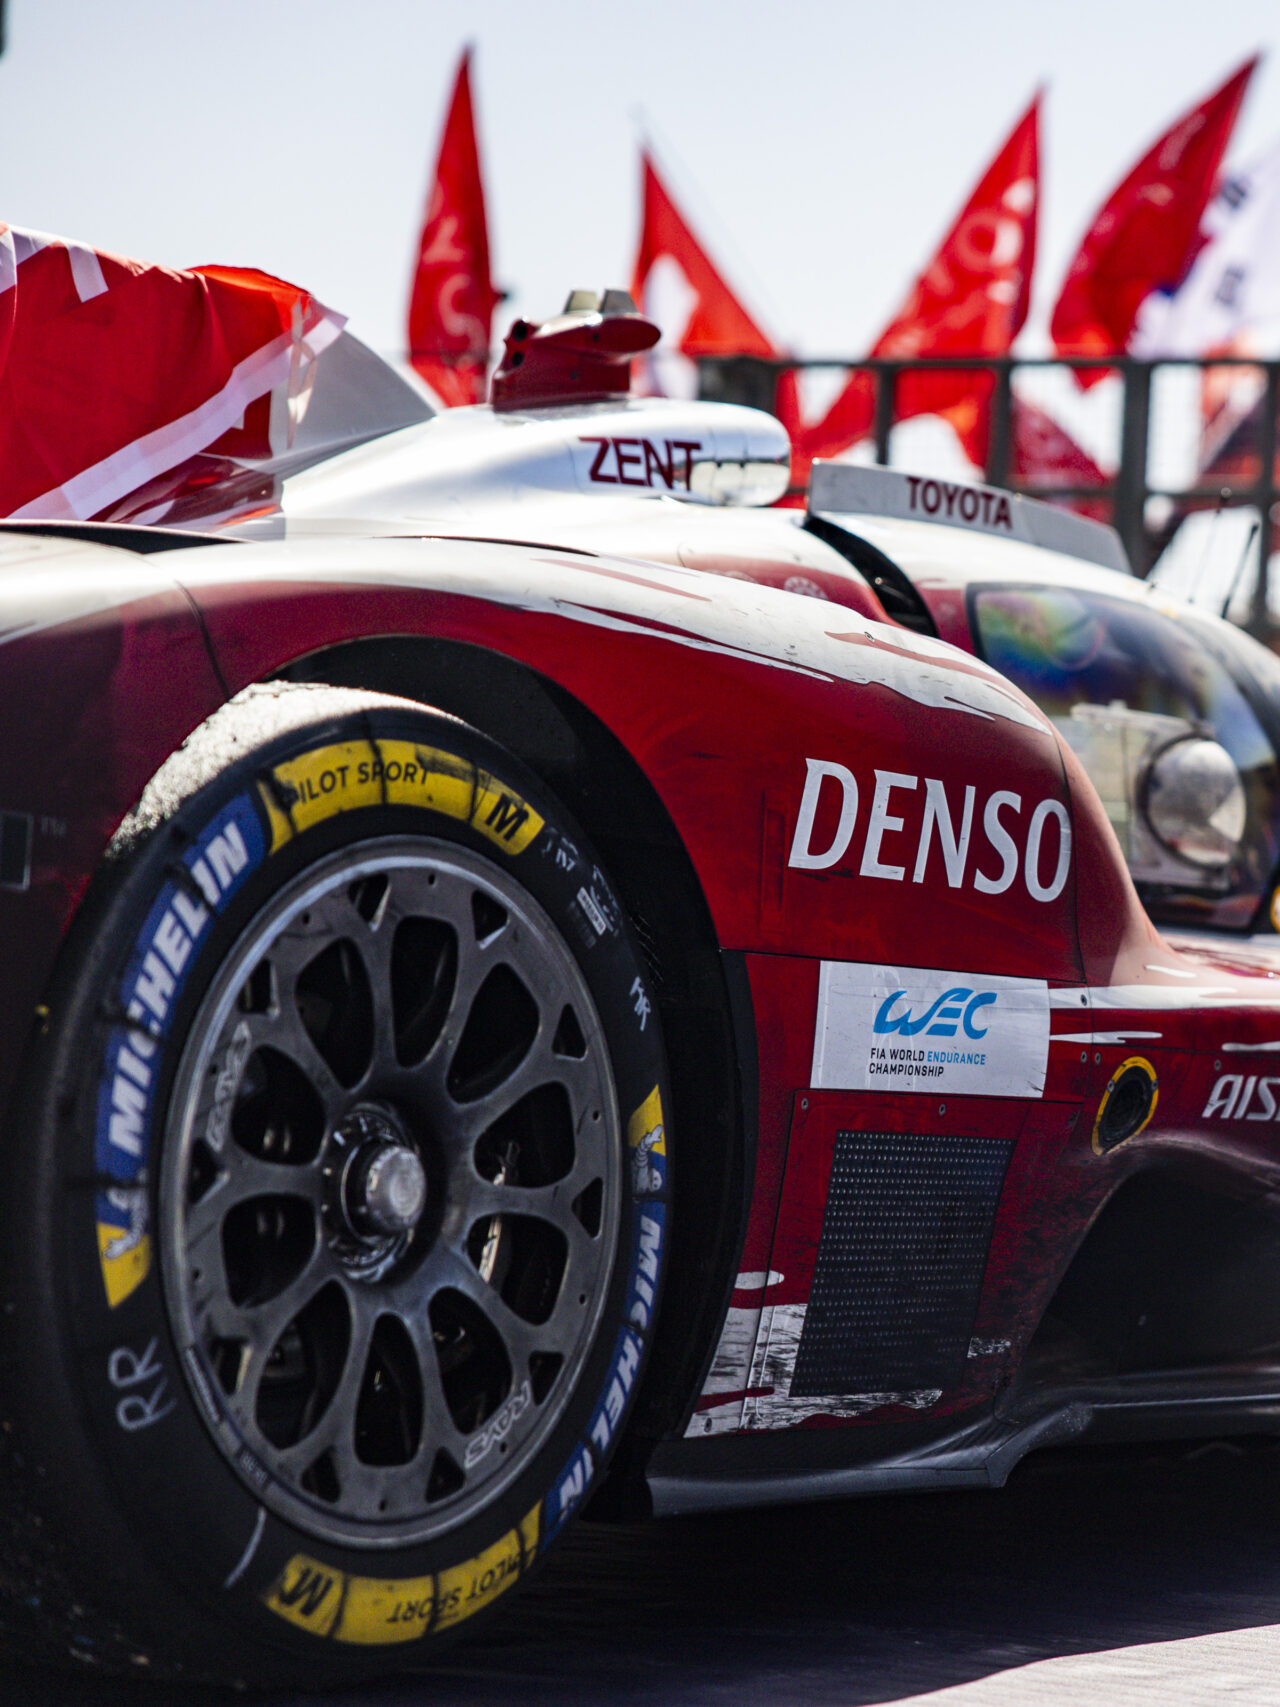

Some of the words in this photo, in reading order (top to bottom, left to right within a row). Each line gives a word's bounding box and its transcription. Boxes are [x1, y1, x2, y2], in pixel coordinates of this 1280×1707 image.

[578, 435, 703, 492] ZENT
[906, 476, 1014, 531] TOYOTA
[284, 764, 350, 805] ILOT
[357, 760, 429, 787] SPORT
[485, 792, 529, 842] M
[787, 757, 1072, 903] DENSO
[107, 821, 251, 1157] MICHELIN
[873, 987, 998, 1040] WEC
[868, 1062, 945, 1078] CHAMPIONSHIP
[870, 1047, 886, 1061] FIA
[889, 1048, 925, 1062] WORLD
[927, 1050, 987, 1066] ENDURANCE
[559, 1214, 662, 1511] MICHELIN
[279, 1567, 334, 1617] M
